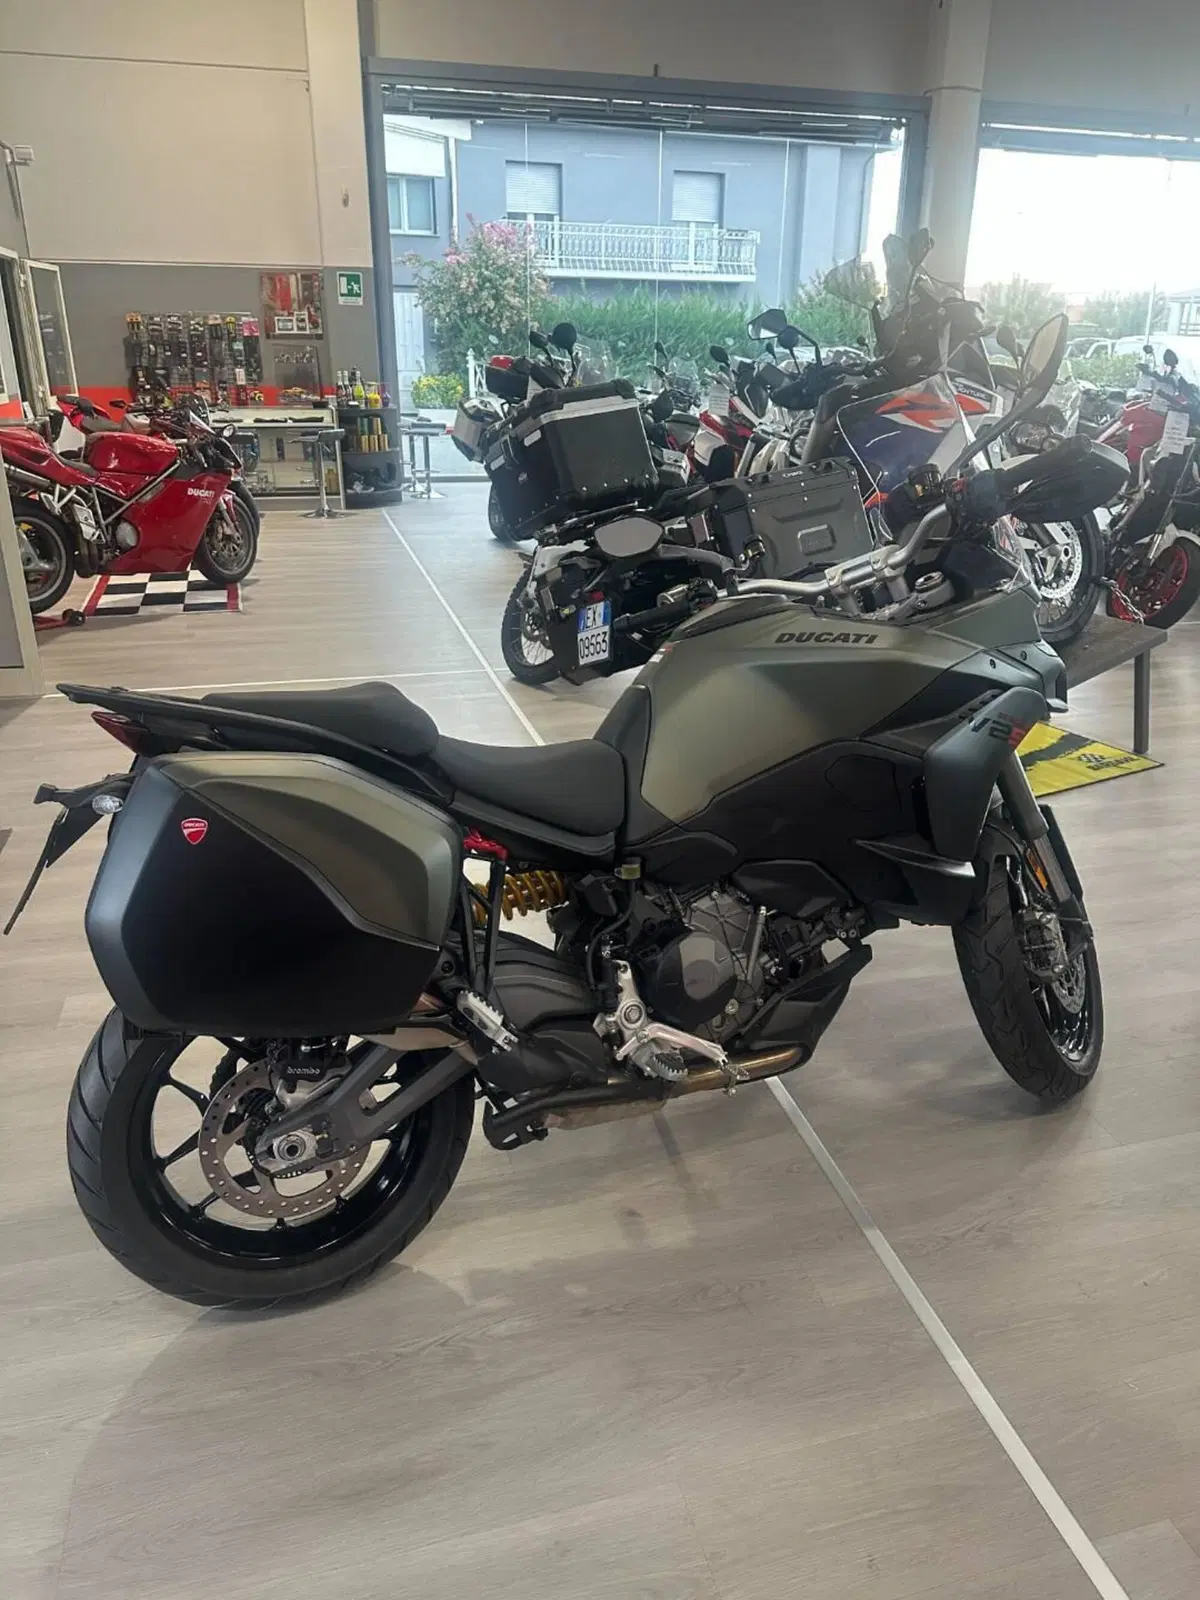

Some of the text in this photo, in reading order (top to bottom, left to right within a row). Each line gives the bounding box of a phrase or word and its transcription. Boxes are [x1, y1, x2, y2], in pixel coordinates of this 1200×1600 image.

[187, 487, 215, 498] DUCATI
[585, 605, 598, 629] EX
[579, 631, 608, 659] 09563
[775, 632, 879, 645] DUCATI
[287, 1065, 321, 1075] brembo
